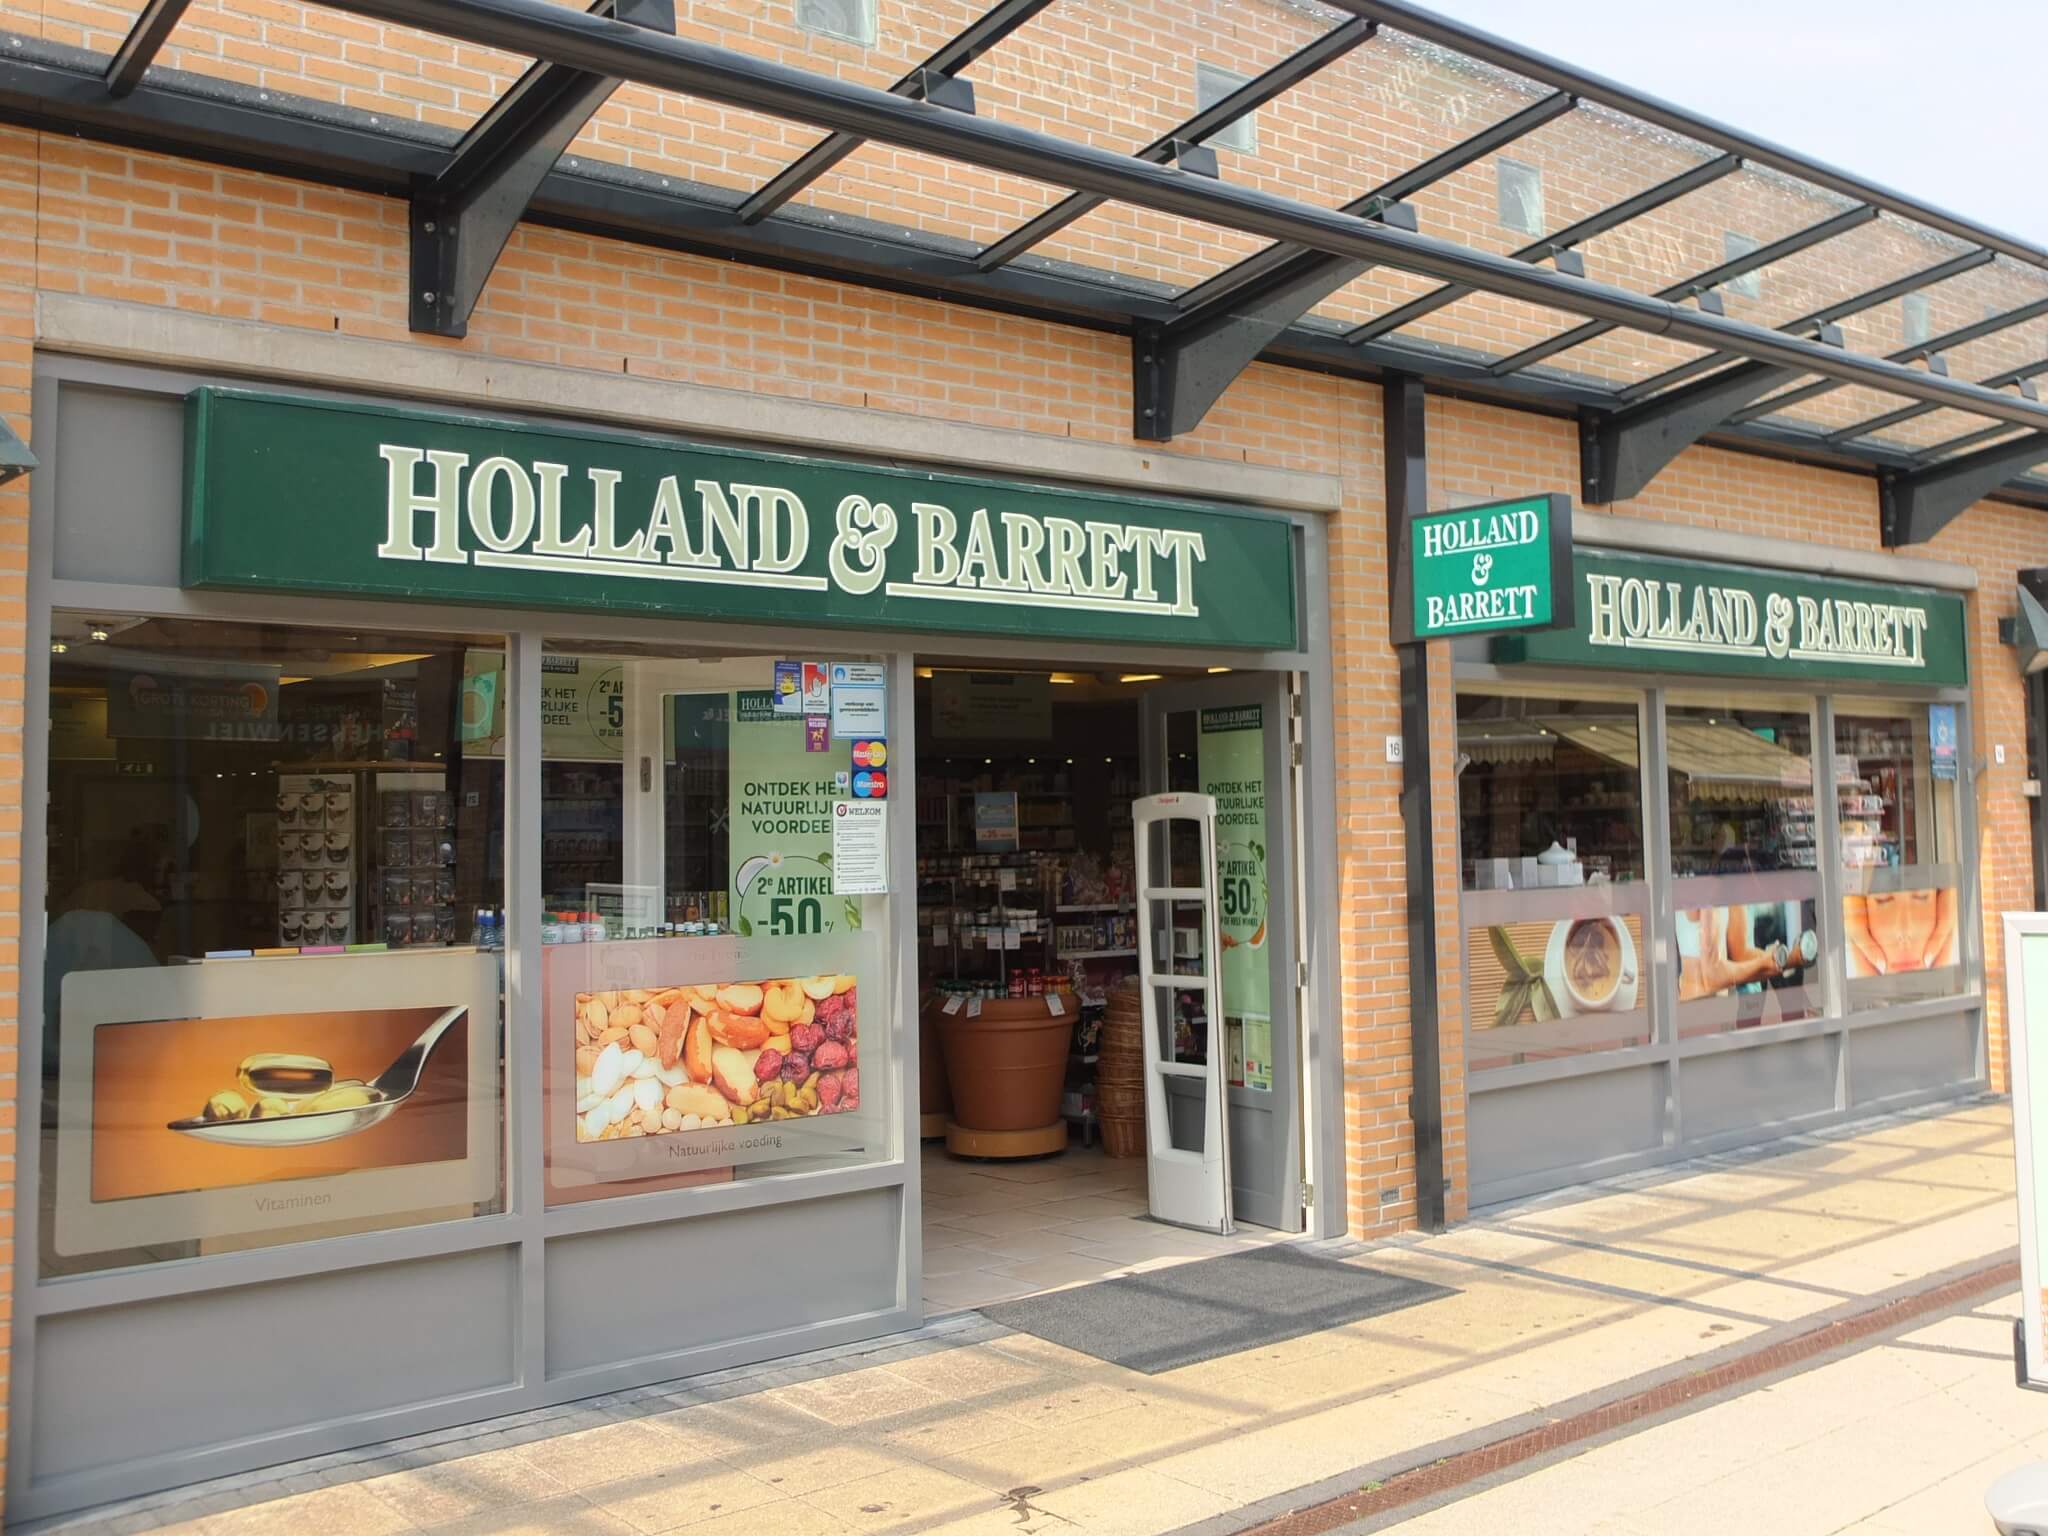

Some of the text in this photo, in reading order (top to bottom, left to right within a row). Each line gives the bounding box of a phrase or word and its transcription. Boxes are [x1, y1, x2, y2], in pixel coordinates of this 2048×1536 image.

[378, 443, 1207, 617] HOLLAND & BARRETT
[1423, 510, 1539, 557] HOLLAND
[1471, 553, 1493, 586] &
[1426, 585, 1538, 628] BARRETT
[1586, 573, 1927, 667] HOLLAND & BARRETT
[554, 688, 576, 699] HET
[1390, 742, 1400, 756] 16
[744, 782, 811, 796] ONTDEK
[1206, 781, 1262, 794] ONTDEK HET
[741, 801, 833, 816] NATUURLIJ
[848, 807, 881, 816] WELKOM
[1215, 813, 1259, 826] OORDEEL
[1226, 860, 1257, 876] ARTIKEL
[757, 877, 834, 895] 2e ARTIKEL
[669, 1134, 783, 1158] Natuurlijke voeding
[255, 1192, 332, 1212] Vitaminen
